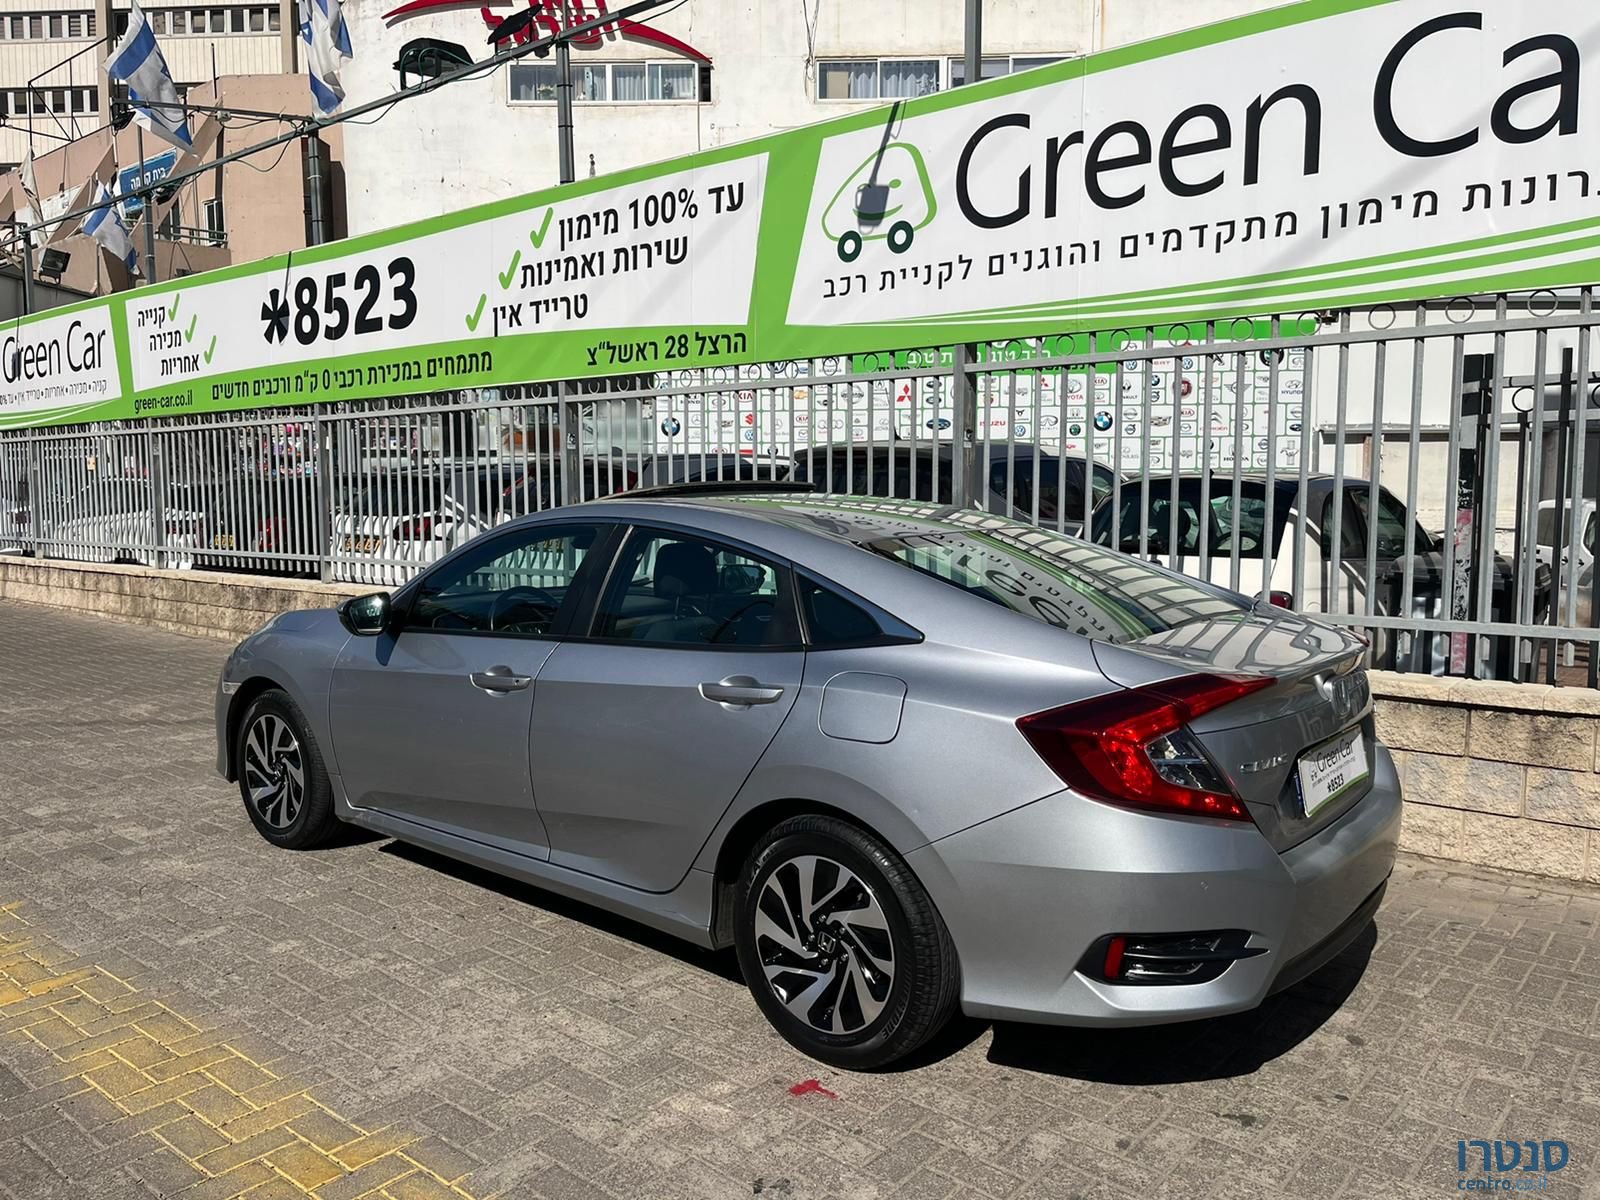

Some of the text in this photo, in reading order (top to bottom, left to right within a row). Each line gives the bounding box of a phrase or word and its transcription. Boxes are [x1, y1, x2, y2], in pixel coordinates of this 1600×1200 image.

[956, 83, 1321, 229] Green
[152, 167, 166, 181] בית
[559, 182, 744, 251] עד 100% מימון
[823, 170, 1600, 298] רונות מימון מתקדמים והוגנים לקניית רכב
[520, 236, 688, 289] שירות ואמינות
[137, 306, 166, 329] קנייה
[492, 293, 588, 337] טרייד אין
[3, 320, 106, 383] Green Car
[150, 329, 182, 351] מכירה
[665, 334, 688, 359] 28
[695, 331, 747, 356] הרצל
[160, 354, 200, 376] אחריות
[367, 360, 422, 385] במכירת
[427, 351, 492, 377] מתמחים
[212, 381, 249, 400] חדשים
[253, 377, 291, 397] ורכבים
[322, 369, 331, 390] 0
[334, 369, 363, 389] רכבי
[134, 389, 193, 414] green-car.co.il
[1317, 747, 1341, 772] Green
[1340, 739, 1354, 759] Car
